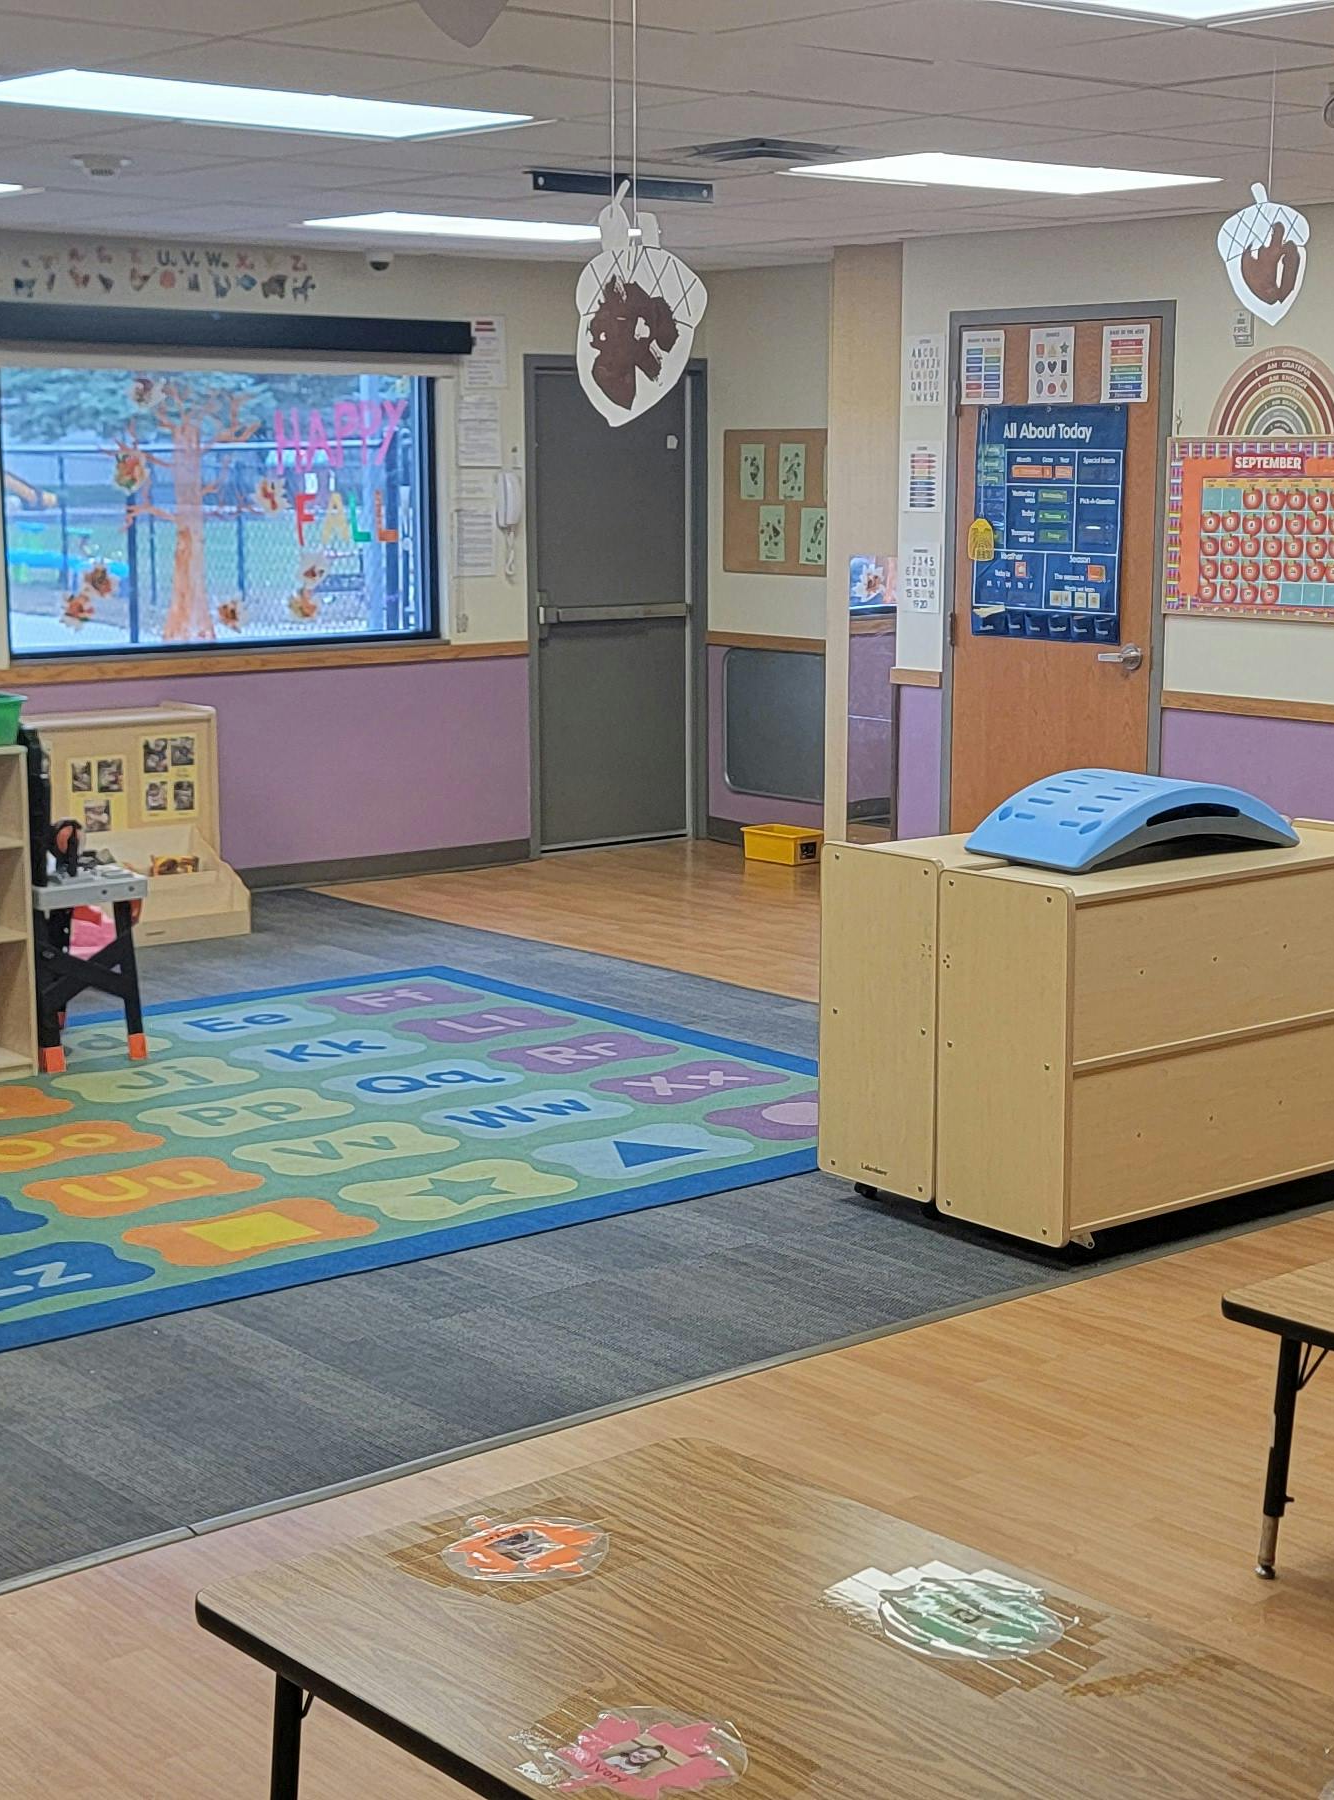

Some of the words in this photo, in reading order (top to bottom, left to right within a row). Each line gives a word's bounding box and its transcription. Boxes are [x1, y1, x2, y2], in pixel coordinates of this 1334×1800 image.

[1267, 362, 1278, 370] AM
[1282, 361, 1311, 378] GRATEFUL
[1269, 374, 1280, 382] AM
[1282, 374, 1308, 389] ENOUGH
[274, 399, 408, 475] HAPPY
[1003, 423, 1017, 439] All
[1019, 423, 1056, 439] About
[1058, 423, 1093, 443] Today
[1235, 456, 1301, 470] SEPTEMBER
[296, 490, 399, 546] FALL
[1070, 555, 1091, 564] Season
[346, 985, 434, 1009] Ff
[187, 1011, 294, 1036] Ee
[267, 1035, 388, 1064] Kk
[540, 1038, 620, 1066] Rr
[115, 1063, 211, 1092] Jj
[354, 1065, 508, 1096] Qq
[622, 1070, 751, 1097] Xx
[192, 1098, 305, 1129] Pp
[444, 1097, 592, 1132] Ww
[273, 1133, 398, 1161] Vv
[60, 1168, 218, 1203] Uu
[586, 1759, 630, 1784] Ivory
